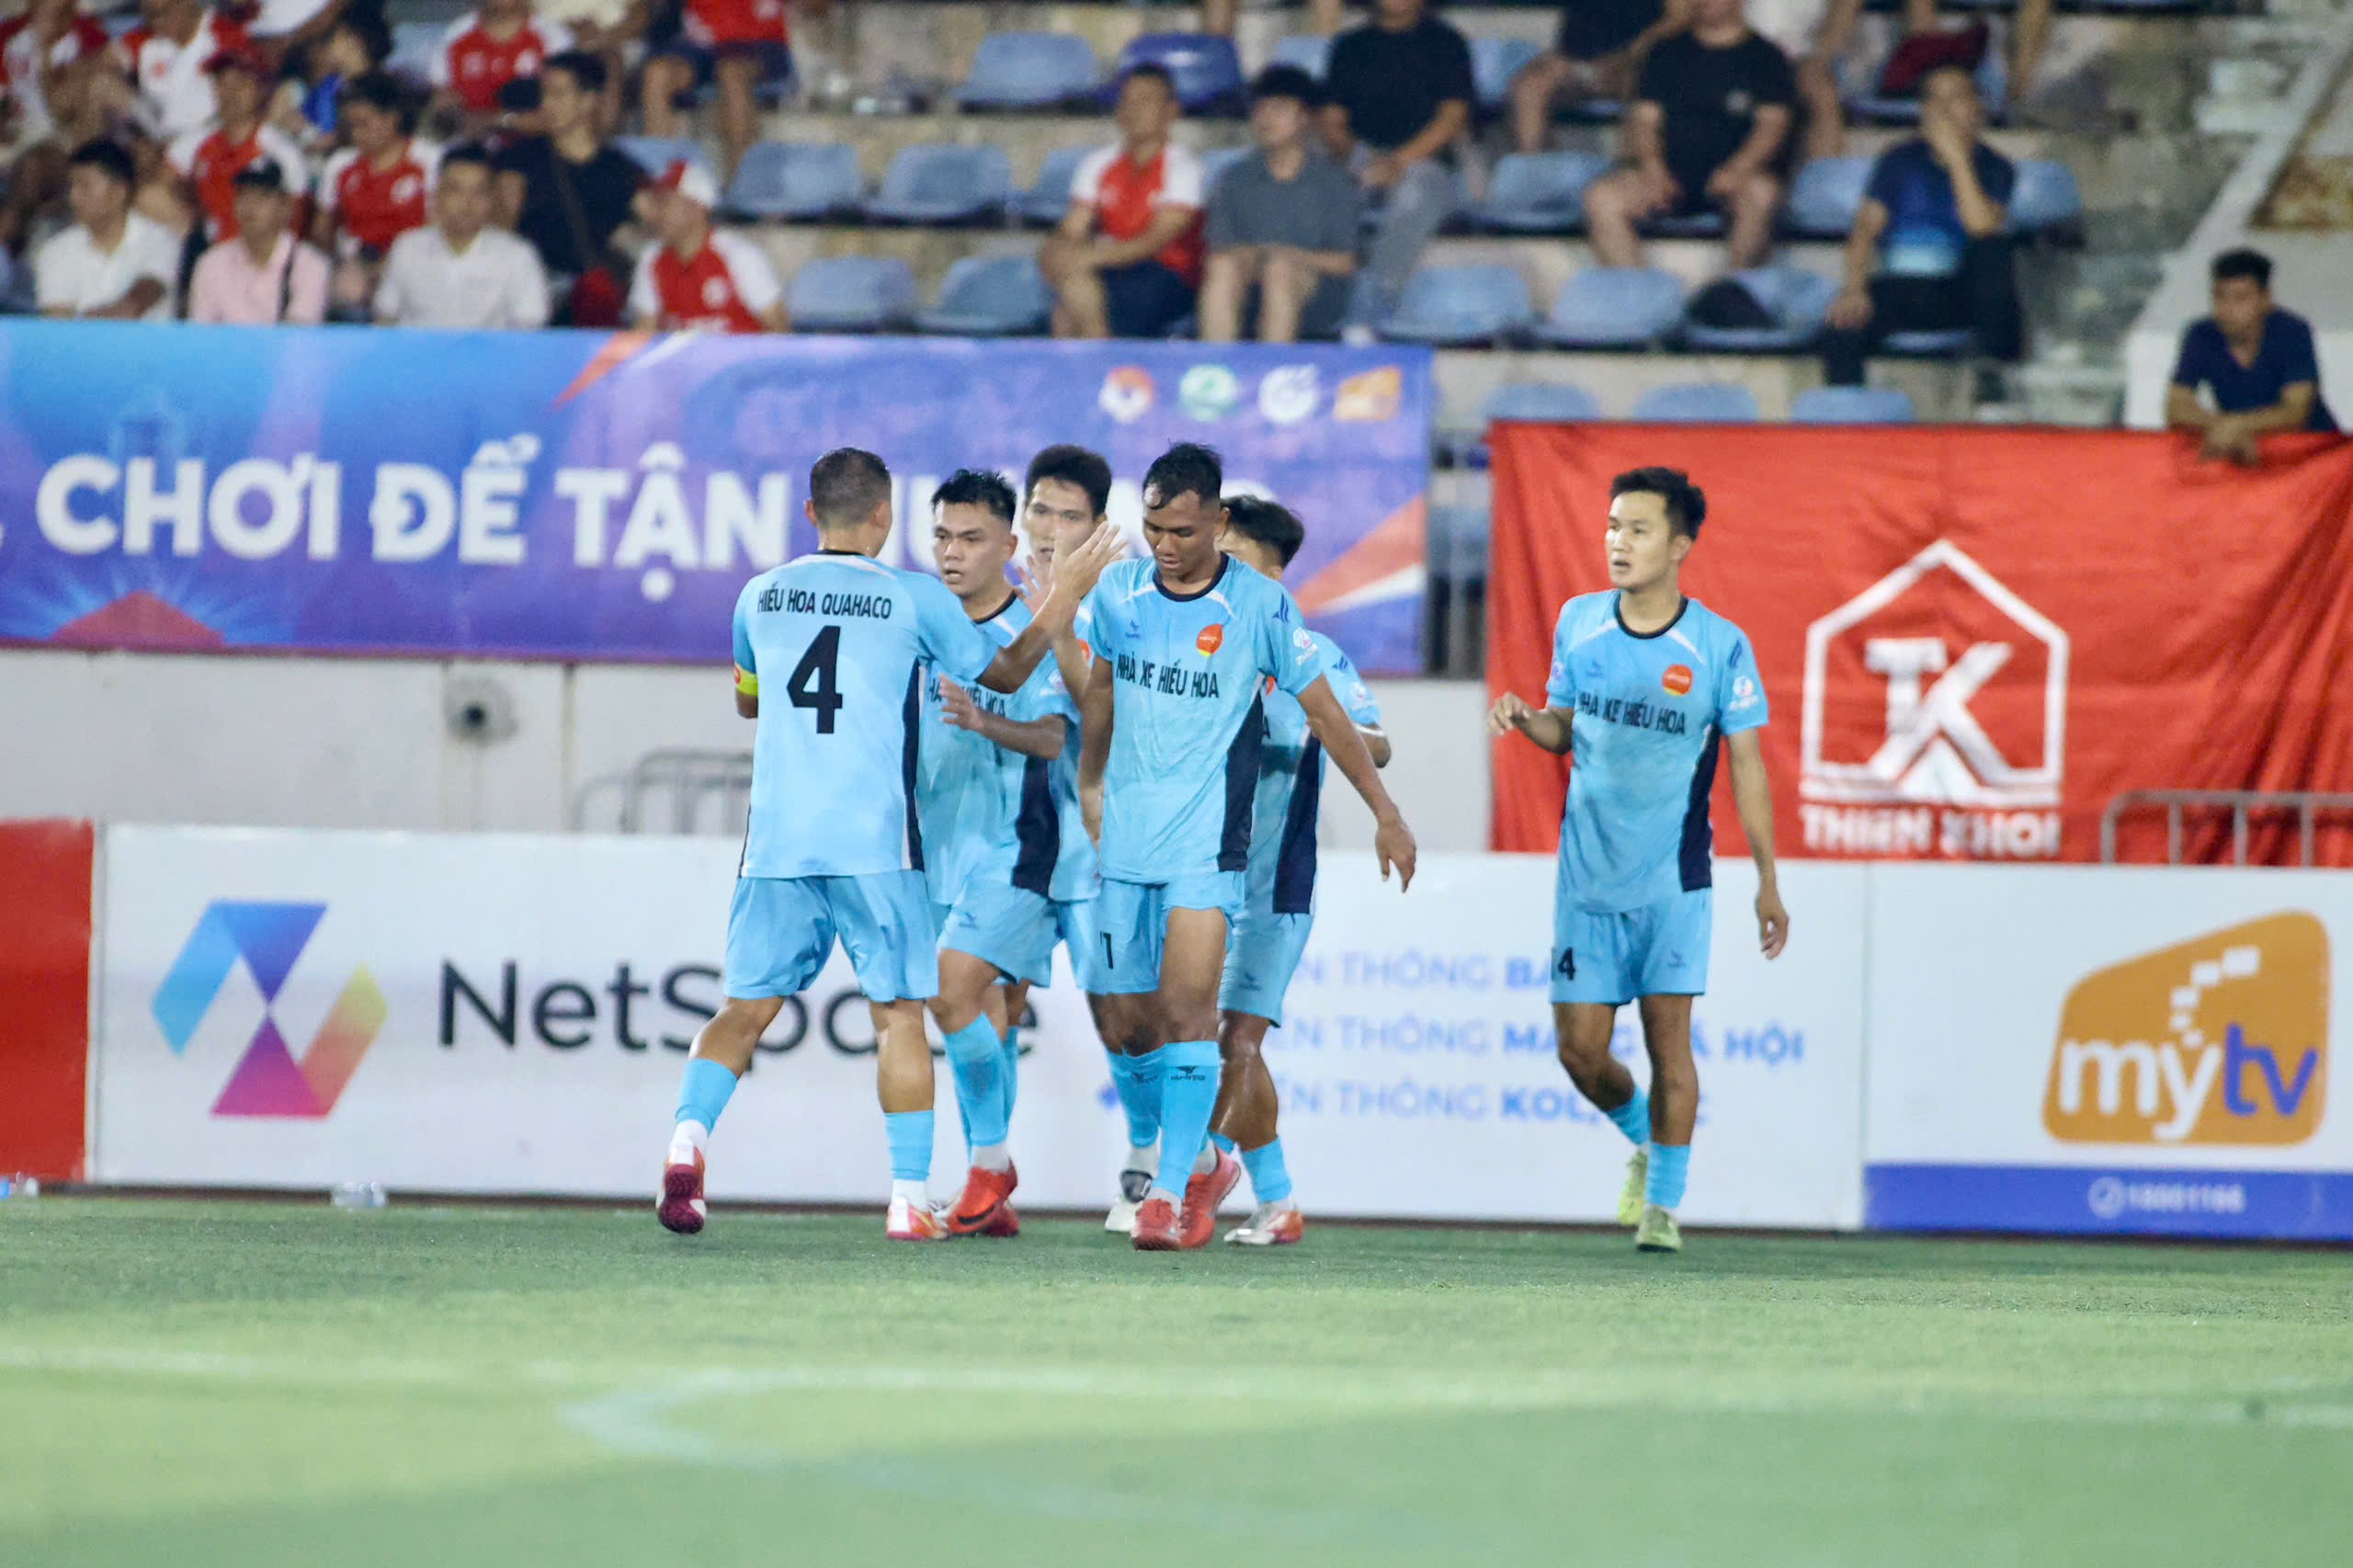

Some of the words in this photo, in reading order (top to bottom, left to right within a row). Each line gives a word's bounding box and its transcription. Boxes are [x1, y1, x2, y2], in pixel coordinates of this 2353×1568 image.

[35, 453, 342, 561] CHƠI
[369, 432, 541, 565] ĐỂ
[553, 440, 791, 603] TẬN
[787, 587, 816, 615] HOA
[821, 591, 892, 619] QUAHACO
[786, 624, 843, 734] 4
[1190, 670, 1221, 699] HOA
[1656, 707, 1687, 735] HOA
[1863, 636, 2015, 785] TK
[1341, 947, 1493, 991] THÔNG
[1338, 1012, 1490, 1055] THÔNG
[1724, 1018, 1804, 1065] HỘI
[1338, 1074, 1489, 1120] THÔNG
[2058, 1020, 2320, 1141] mytv
